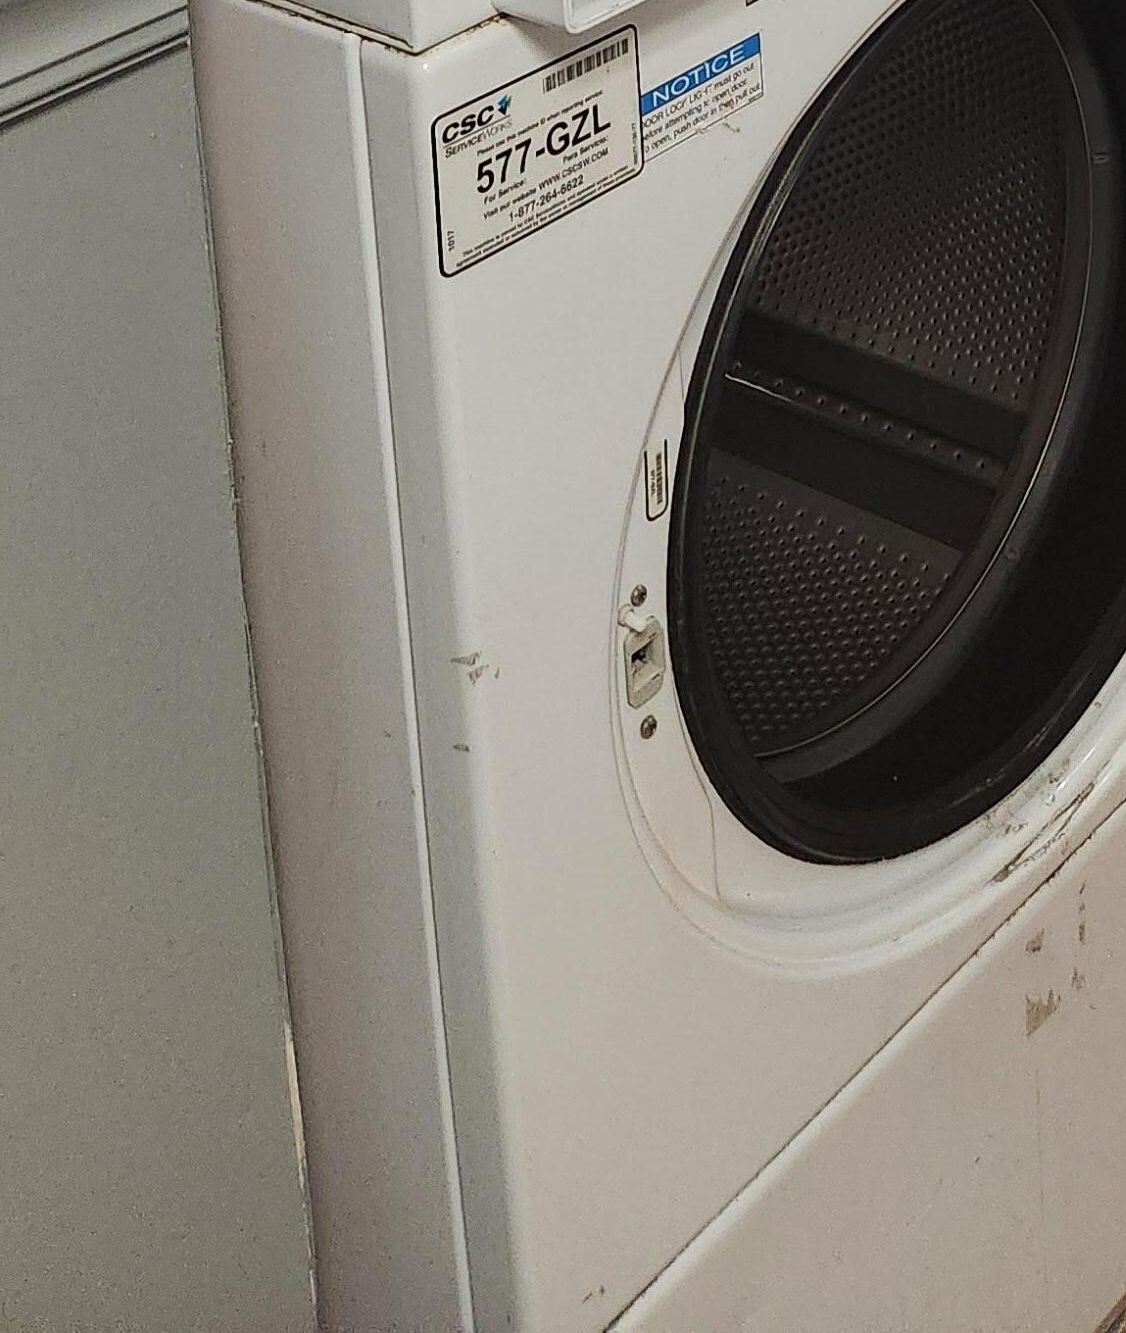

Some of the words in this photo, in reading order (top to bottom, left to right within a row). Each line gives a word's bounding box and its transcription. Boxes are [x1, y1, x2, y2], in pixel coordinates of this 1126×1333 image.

[652, 43, 746, 107] NOTICE
[714, 75, 731, 89] must
[732, 70, 741, 80] go
[743, 62, 754, 73] out
[442, 105, 495, 144] CSC
[665, 104, 702, 129] attempting
[712, 90, 730, 102] open
[673, 122, 692, 139] push
[693, 111, 708, 125] door
[735, 90, 747, 104] pull
[476, 103, 611, 193] 577-GZL
[563, 151, 578, 164] Para
[483, 208, 499, 220] Visit
[512, 188, 537, 205] website
[538, 147, 609, 190] WWW.CSCSW.COM
[483, 193, 496, 205] For
[509, 175, 584, 222] 1-877-264-6622
